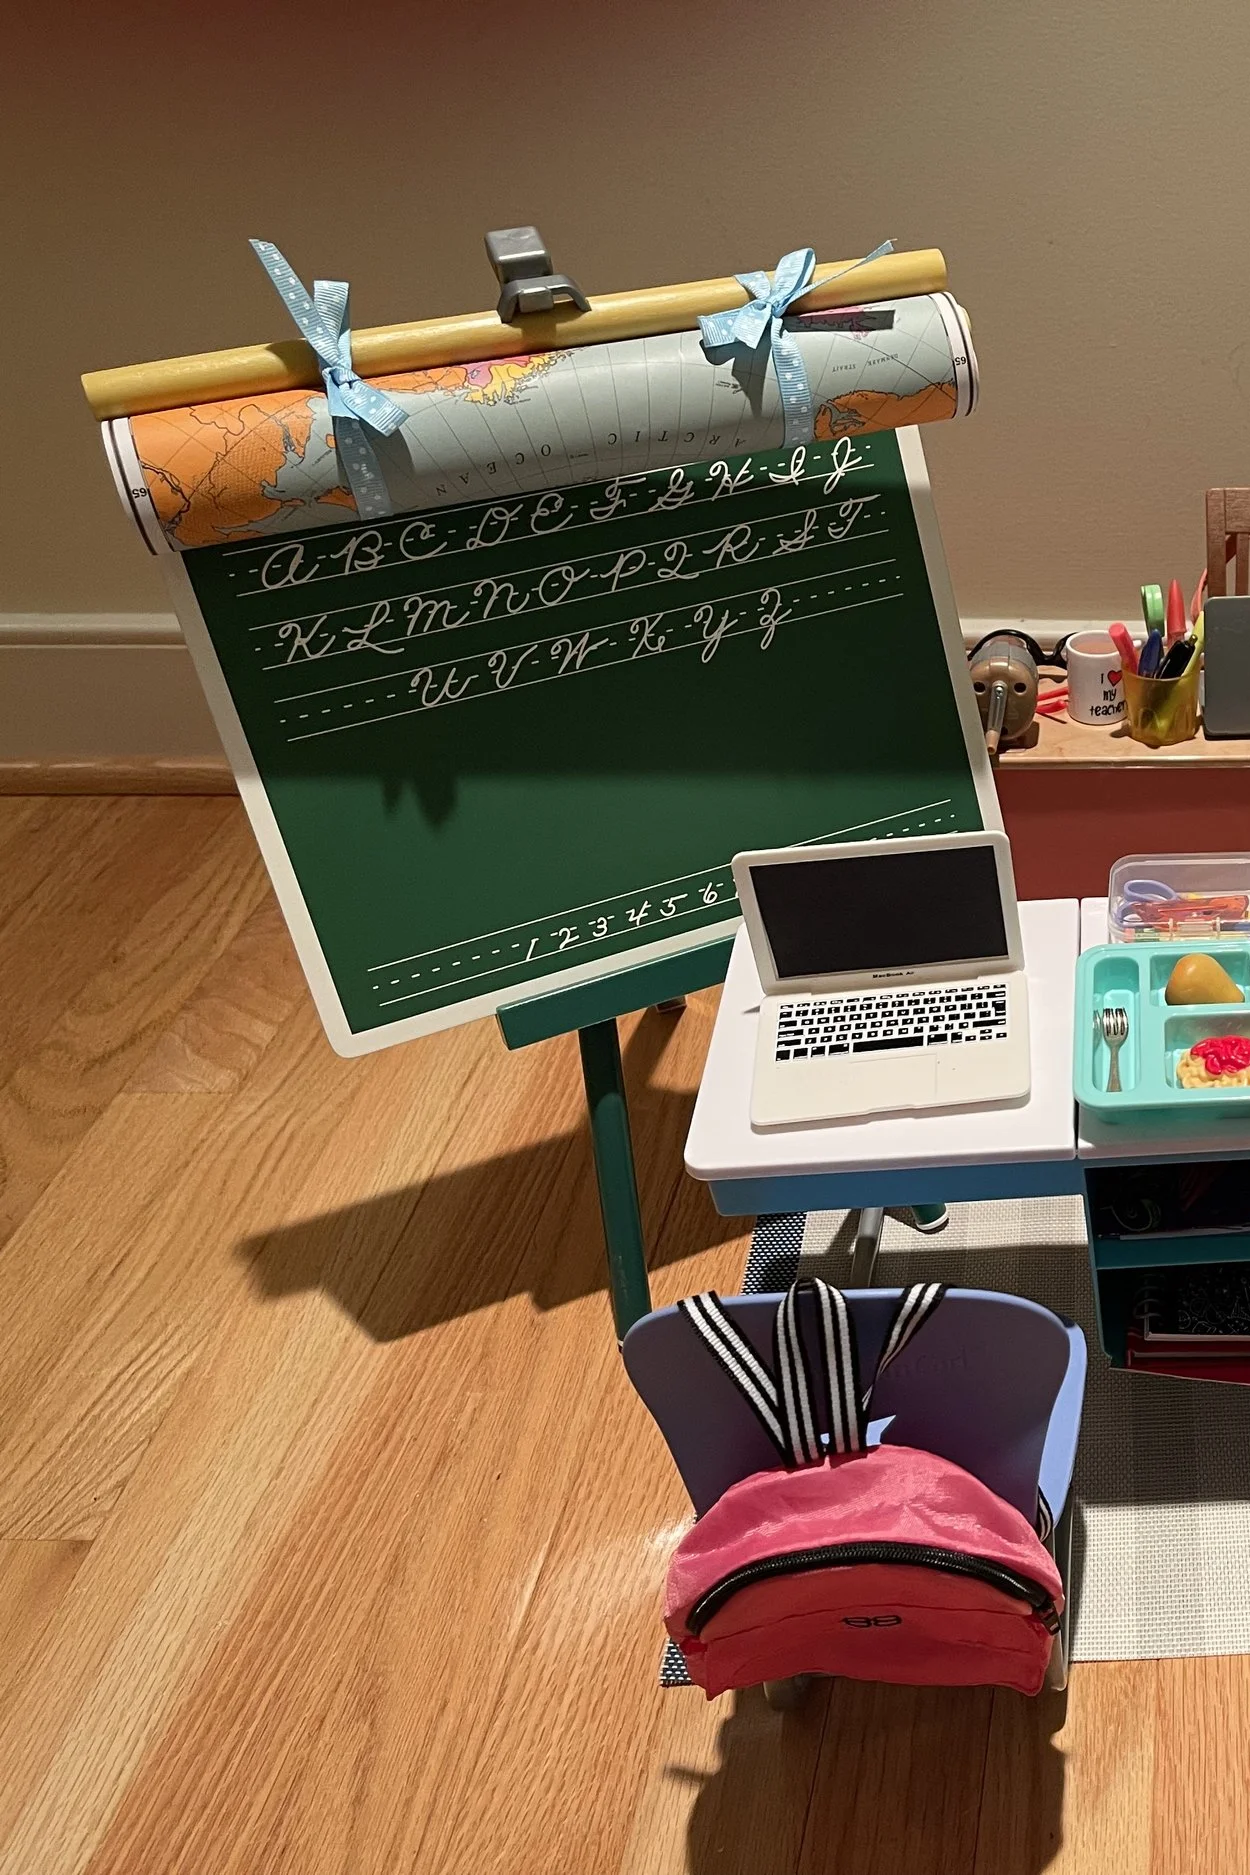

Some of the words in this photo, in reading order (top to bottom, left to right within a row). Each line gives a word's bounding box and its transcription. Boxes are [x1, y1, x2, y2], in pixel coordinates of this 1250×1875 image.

[955, 356, 967, 366] 65
[607, 430, 747, 448] ARCTIC
[435, 444, 552, 497] OCEAN
[131, 487, 147, 498] 65
[261, 543, 320, 589] A
[330, 530, 385, 575] B
[400, 521, 448, 560] C
[466, 504, 523, 550] D
[530, 493, 574, 534] E
[709, 457, 755, 501] H
[823, 436, 863, 495] J
[278, 615, 336, 663] K
[342, 600, 405, 653] L
[403, 596, 470, 636] M
[473, 578, 530, 619] N
[538, 565, 590, 607] O
[600, 549, 647, 592] P
[702, 524, 760, 569] R
[772, 509, 818, 555] S
[410, 667, 475, 707] U
[488, 645, 538, 689] V
[551, 632, 608, 674] W
[694, 604, 738, 664] Y
[1100, 673, 1105, 684] I
[1103, 688, 1117, 701] my
[1090, 700, 1127, 716] teacher
[526, 937, 539, 960] 1
[558, 927, 579, 950] 2
[592, 916, 607, 938] 3
[625, 900, 651, 926] 4
[659, 894, 688, 917] 5
[702, 882, 718, 904] 6
